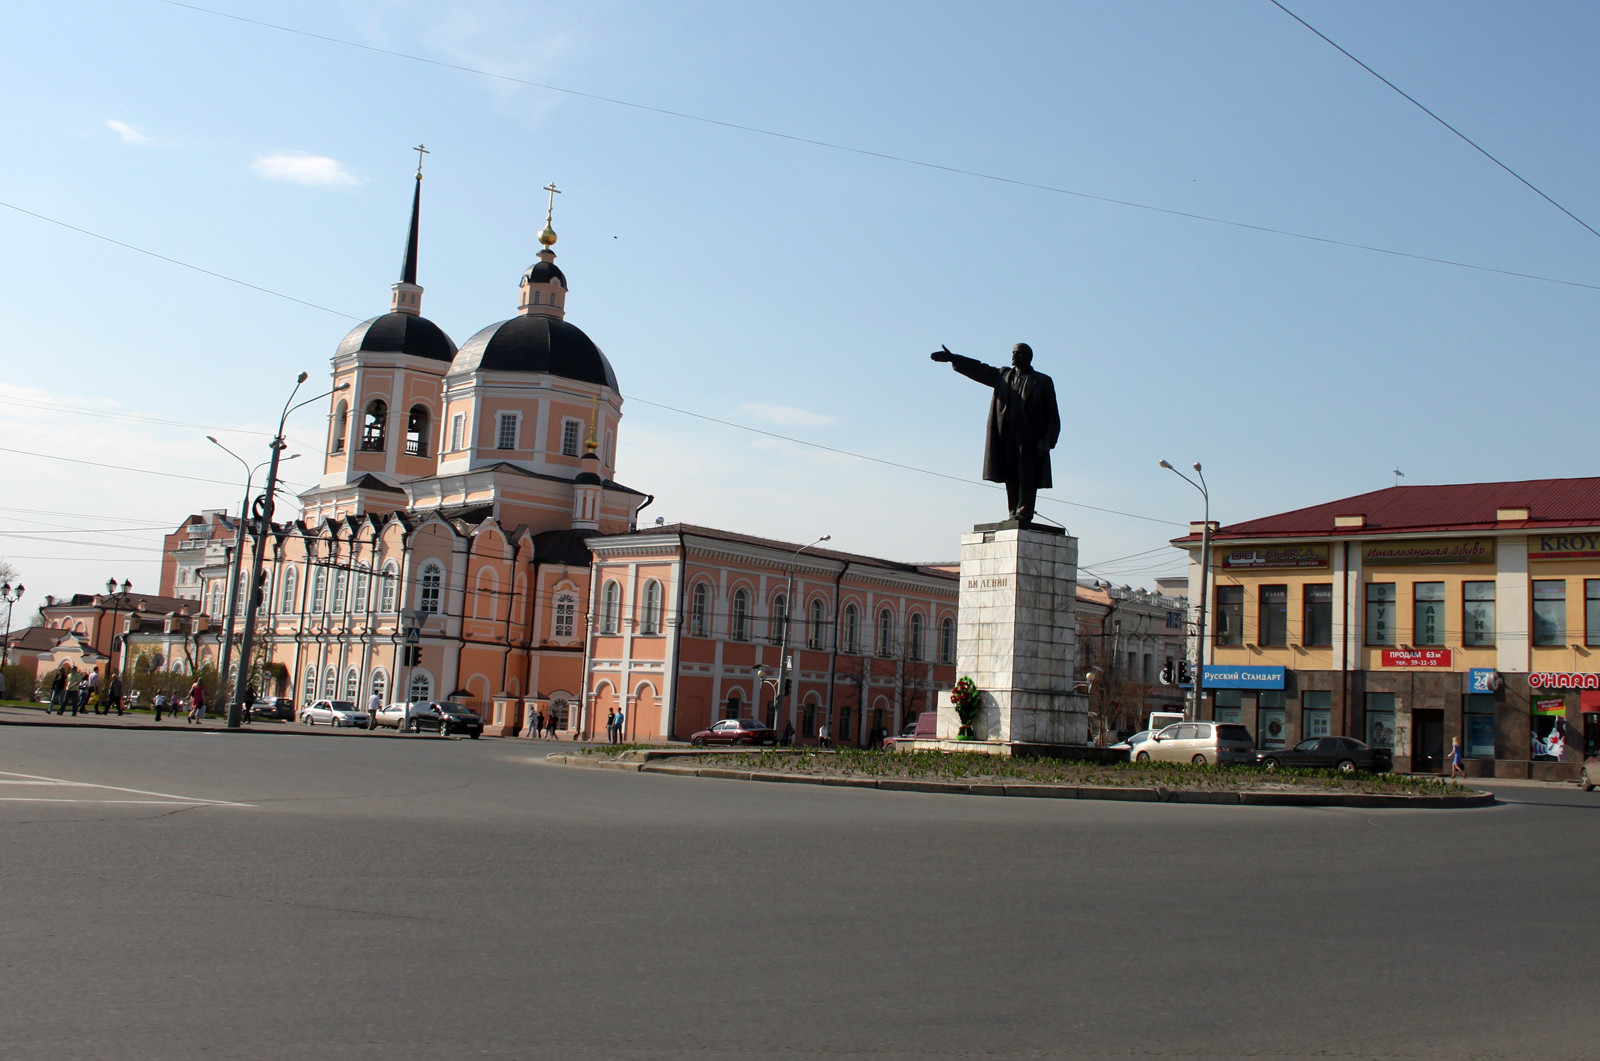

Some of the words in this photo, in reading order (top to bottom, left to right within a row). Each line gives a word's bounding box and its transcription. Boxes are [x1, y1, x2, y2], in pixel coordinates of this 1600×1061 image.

[1230, 549, 1317, 561] OBLOJKA
[980, 577, 1008, 588] ЛЕНИН
[1389, 651, 1422, 659] ПРОДАМ
[1474, 675, 1488, 686] 24
[1528, 672, 1599, 688] O'HARA
